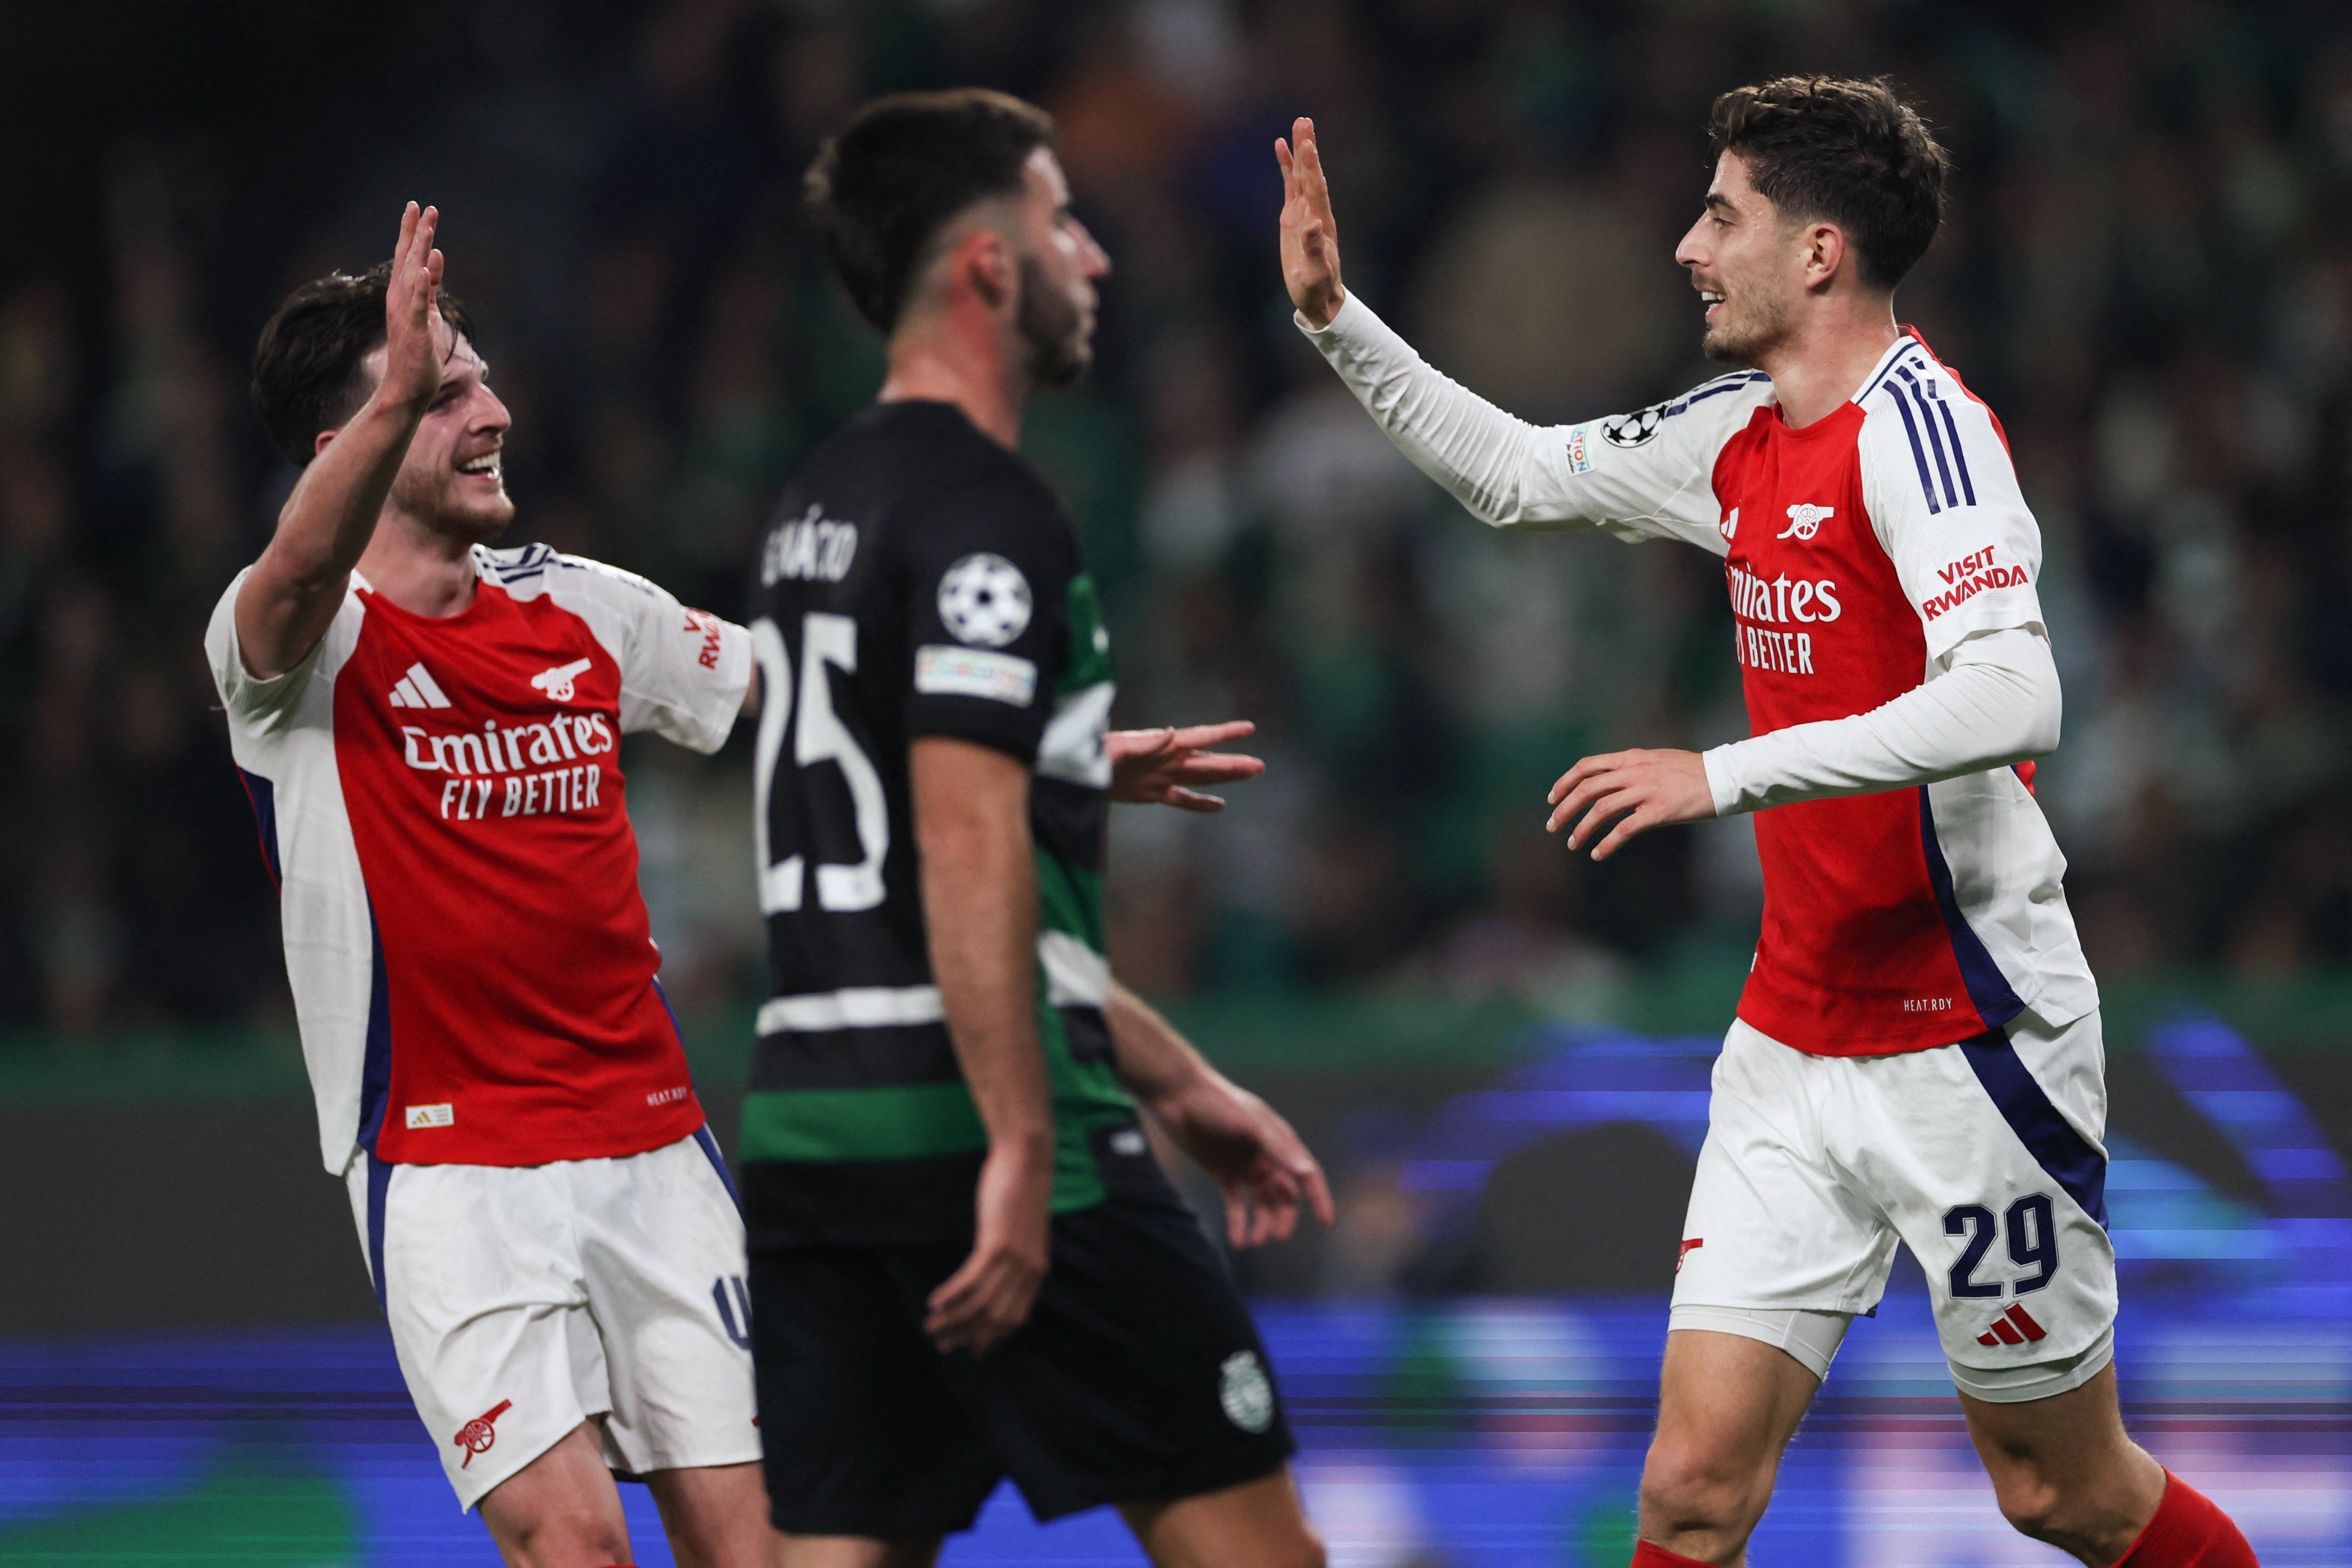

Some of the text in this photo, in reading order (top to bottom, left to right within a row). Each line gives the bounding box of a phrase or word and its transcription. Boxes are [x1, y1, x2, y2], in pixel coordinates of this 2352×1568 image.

[1724, 562, 1842, 622] mirates
[1922, 565, 2029, 622] RWANDA
[1936, 545, 1995, 585] VISIT
[1746, 626, 1815, 674] BETTER
[401, 711, 613, 775] Emirates
[749, 611, 891, 913] 25
[440, 764, 600, 820] FLY BETTER
[1904, 998, 1952, 1012] HEAT.RDY
[1942, 1192, 2060, 1299] 29
